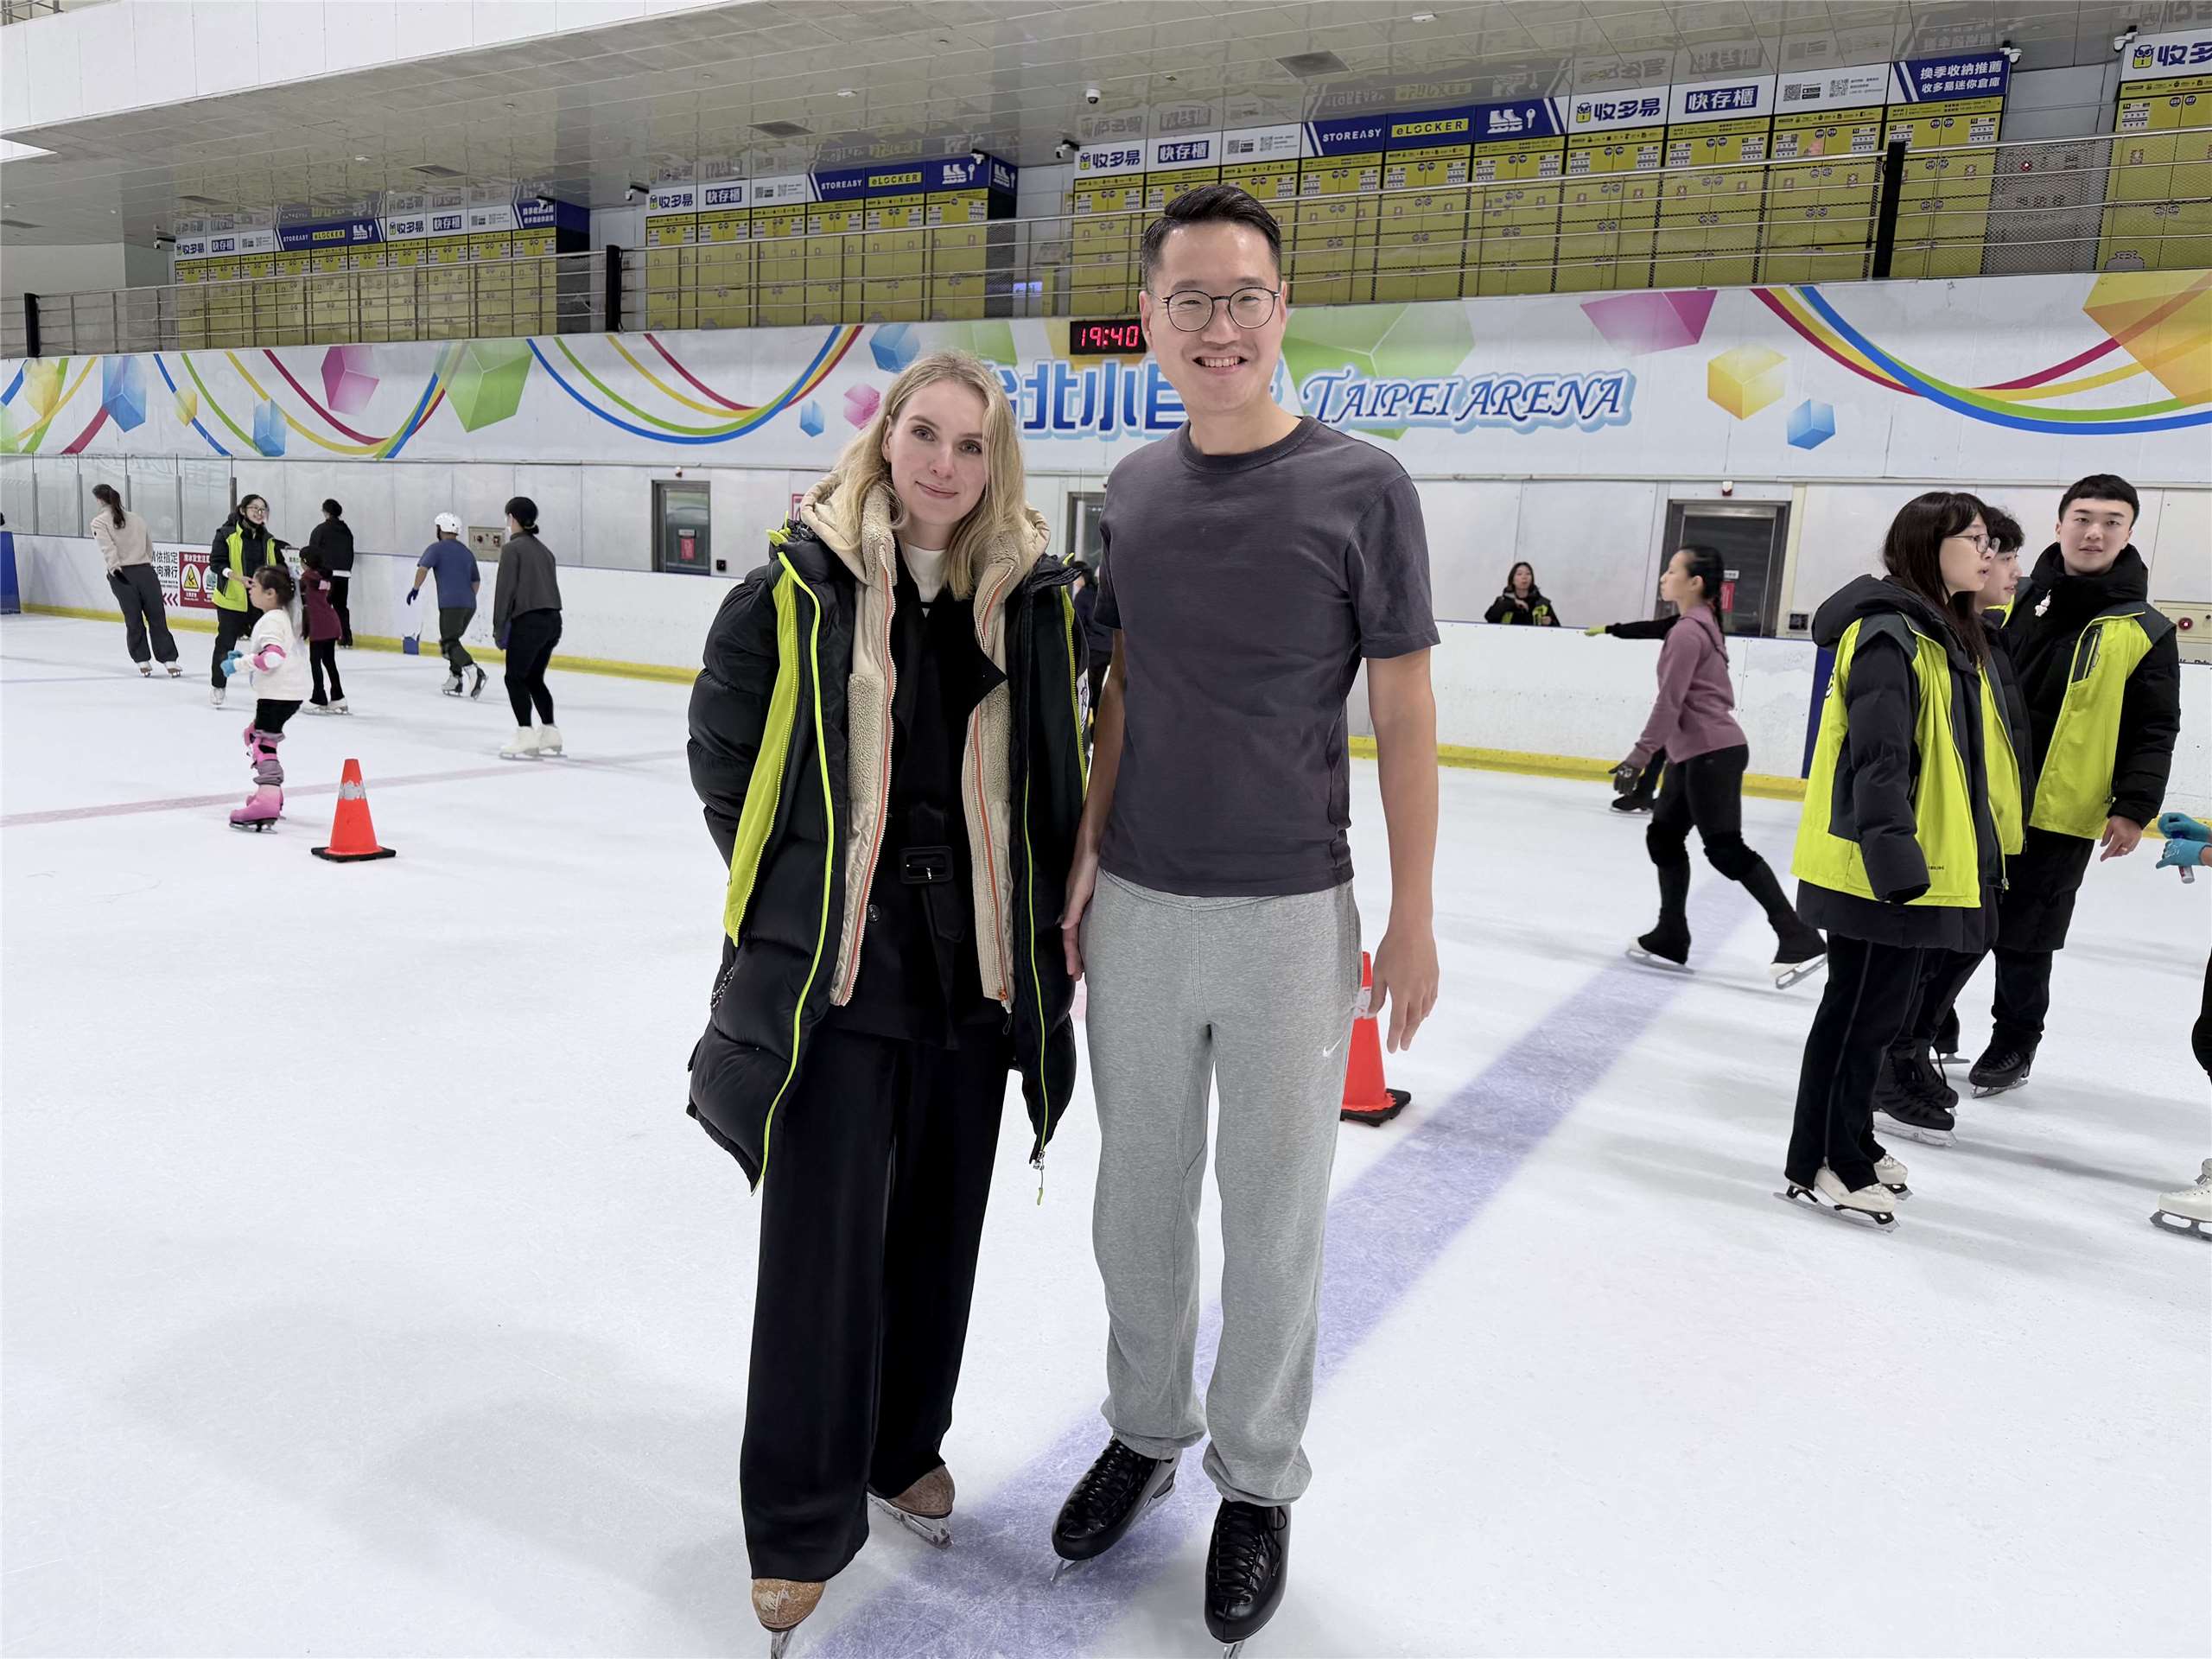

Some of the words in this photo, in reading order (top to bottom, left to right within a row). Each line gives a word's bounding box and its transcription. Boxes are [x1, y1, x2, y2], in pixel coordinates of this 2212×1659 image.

[1920, 60, 2002, 80] 換季收納推薦
[1921, 76, 2001, 94] 收多易迷你倉庫
[1688, 86, 1755, 112] 快存櫃
[1593, 97, 1661, 122] 收多易
[1322, 128, 1382, 143] STOREASY
[1395, 120, 1463, 137] eLOCKER
[1092, 149, 1141, 169] 收多易
[1159, 141, 1208, 162] 快存櫃
[821, 179, 862, 191] STOREASY
[871, 173, 919, 186] eLOCKER
[658, 193, 693, 209] 收多易
[1079, 325, 1140, 347] 19:40
[1454, 375, 1624, 422] ARENA
[153, 564, 178, 579] 向滑行
